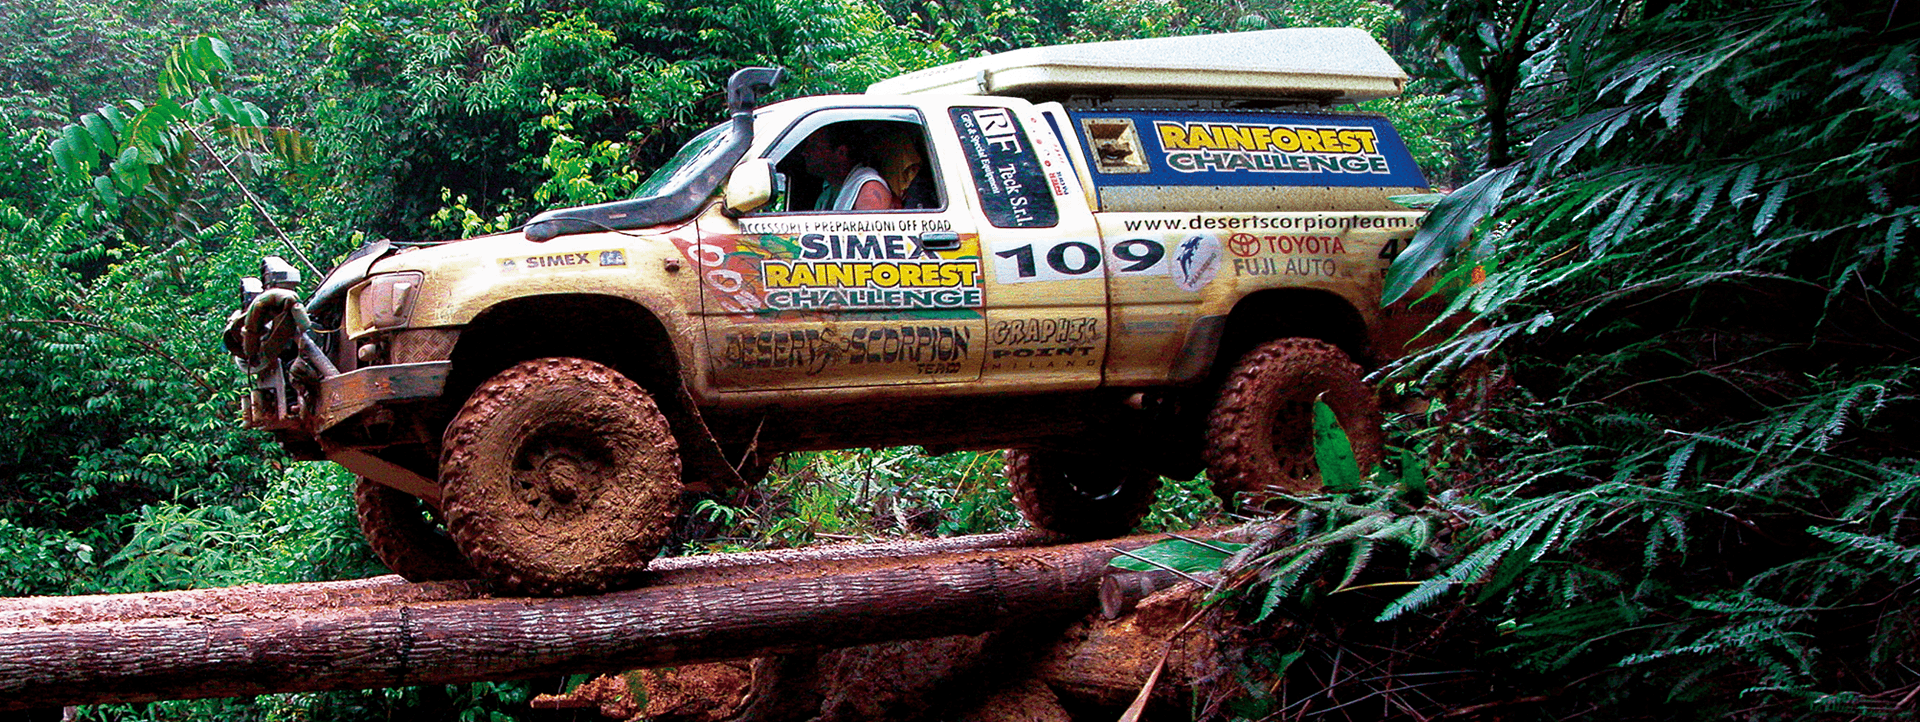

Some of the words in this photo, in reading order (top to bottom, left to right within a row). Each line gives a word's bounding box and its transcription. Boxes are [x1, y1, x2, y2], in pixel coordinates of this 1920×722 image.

[960, 113, 975, 128] GPS
[970, 134, 988, 159] Special
[1155, 121, 1378, 154] RAINFOREST
[1167, 152, 1390, 174] CHALLENGE
[999, 163, 1022, 195] Teck
[740, 221, 801, 235] ACCESSORI
[814, 219, 895, 233] PREPARAZIONI
[899, 219, 918, 231] OFF
[921, 219, 951, 231] ROAD
[801, 233, 940, 260] SIMEX
[1263, 235, 1346, 255] TOYOTA
[526, 252, 591, 268] SIMEX
[995, 238, 1165, 278] 109
[1233, 257, 1277, 276] FUJI
[1285, 257, 1337, 276] AUTO
[763, 260, 979, 289] RAINFOREST
[765, 289, 981, 308] CHALLENGE
[993, 317, 1099, 345] GRAPHIC
[850, 325, 970, 363] SCORPION
[993, 346, 1095, 359] POINT
[991, 359, 1097, 370] MILANO
